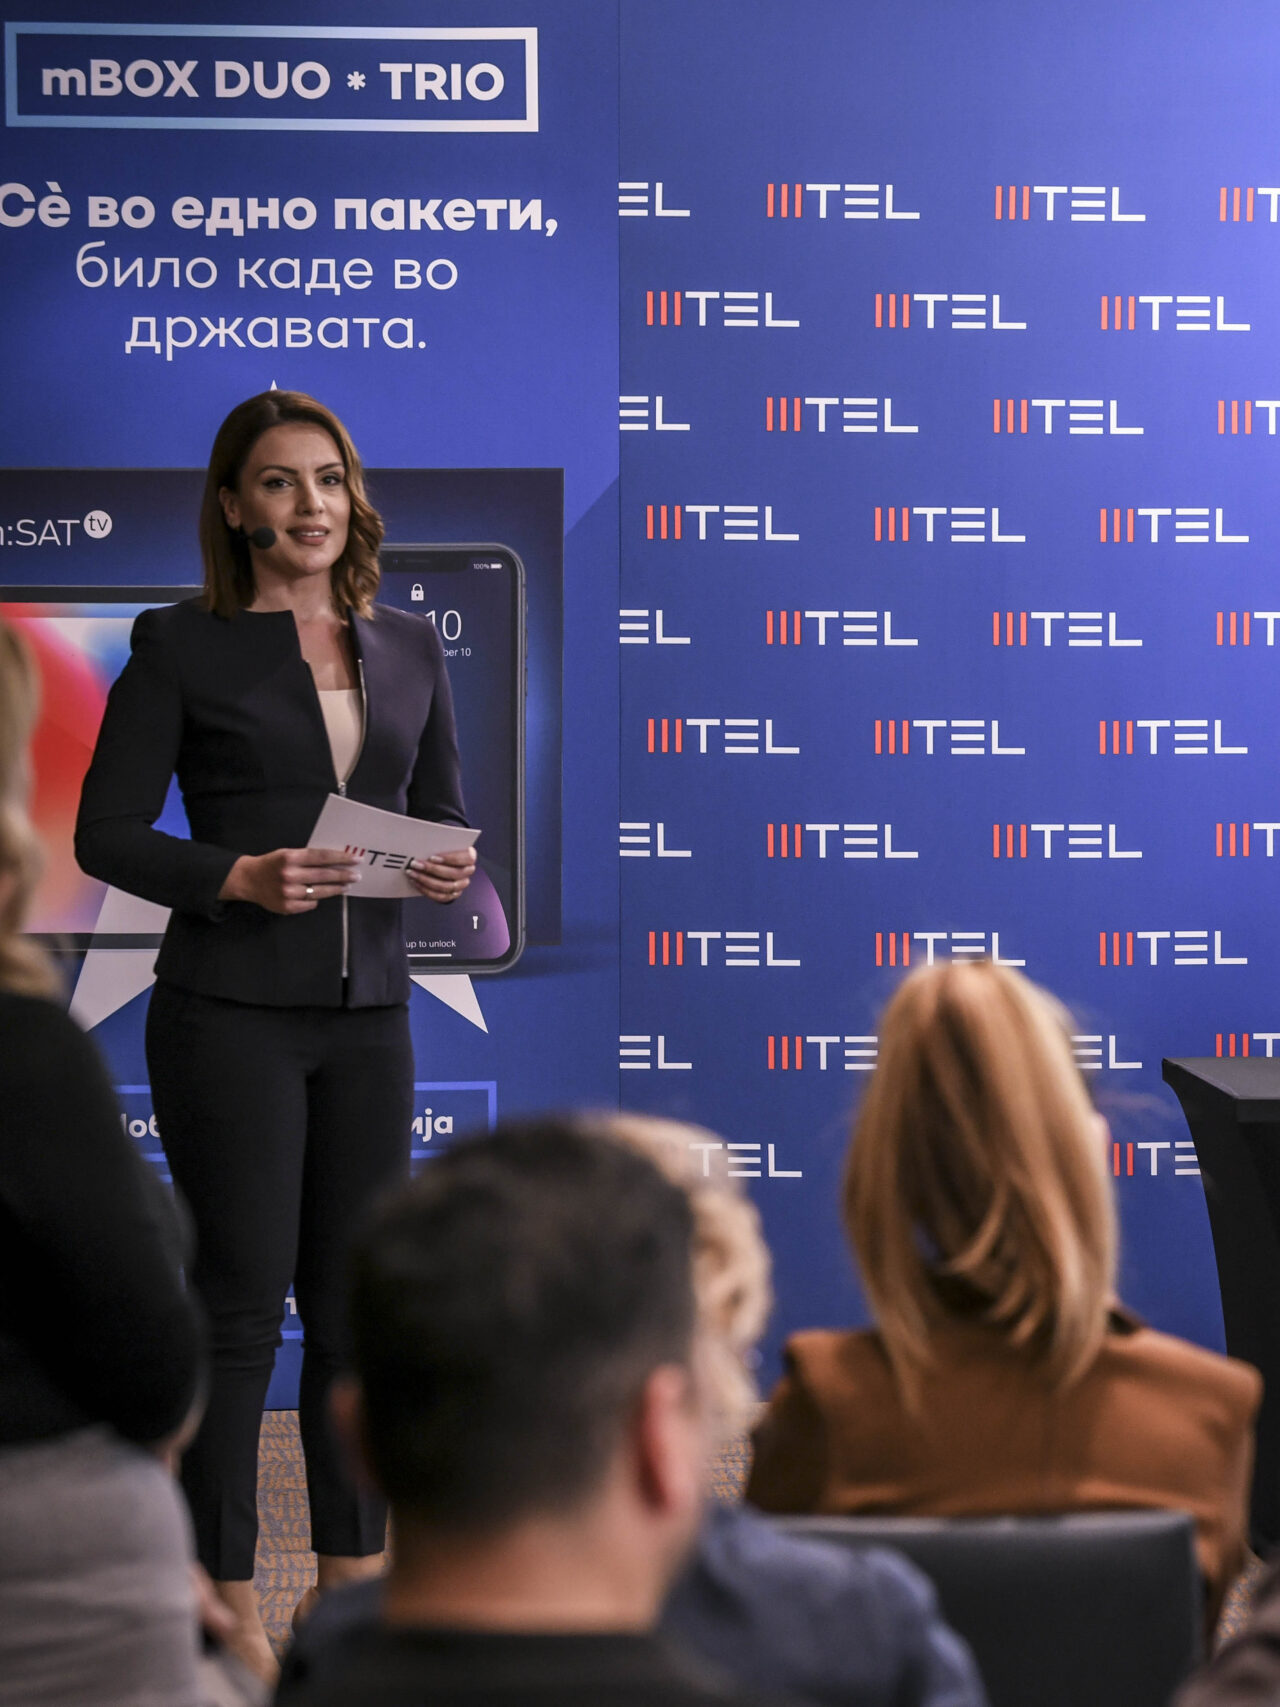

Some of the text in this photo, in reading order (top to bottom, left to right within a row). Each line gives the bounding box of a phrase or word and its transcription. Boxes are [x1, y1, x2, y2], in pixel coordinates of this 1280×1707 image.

[41, 59, 505, 101] mBOX DUO TRIO
[88, 196, 156, 229] во
[171, 196, 317, 237] едно
[334, 198, 558, 237] пакети,
[75, 240, 459, 296] било каде во
[125, 315, 427, 361] државата.
[461, 648, 471, 656] 10
[429, 940, 456, 948] unlock
